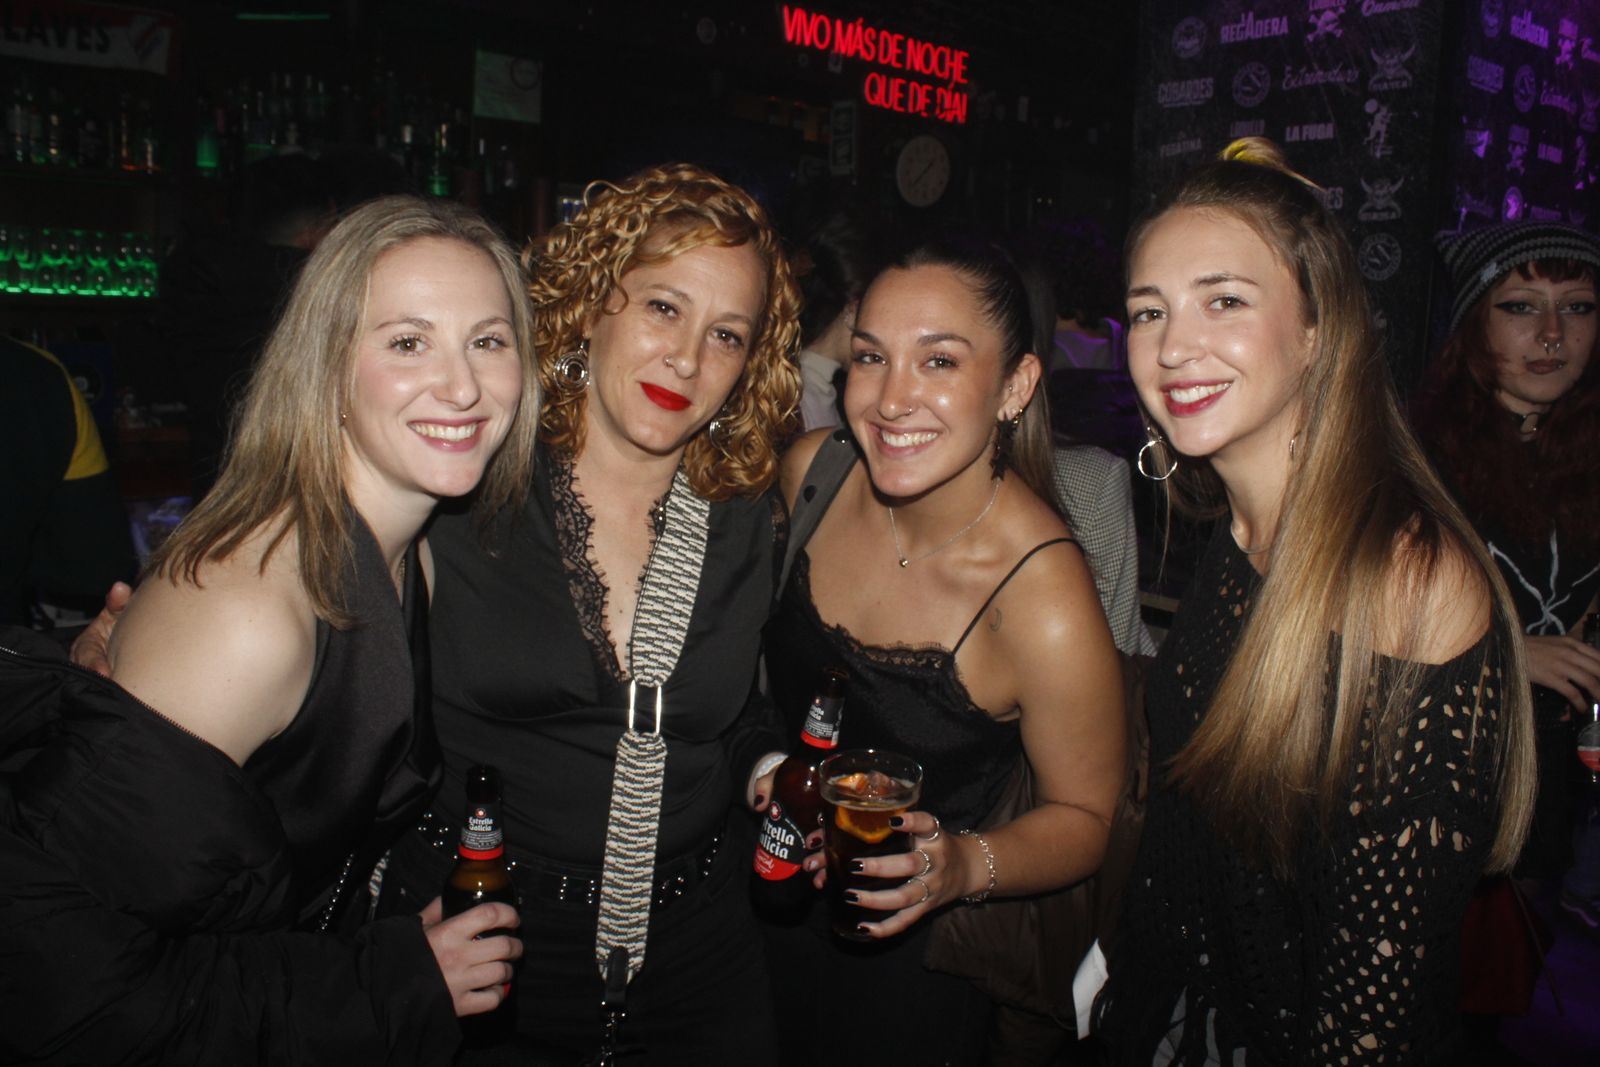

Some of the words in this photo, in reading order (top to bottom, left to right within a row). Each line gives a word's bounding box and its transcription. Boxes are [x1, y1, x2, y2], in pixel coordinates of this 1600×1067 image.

[784, 5, 832, 50] VIVO
[835, 17, 876, 61] MÁS
[878, 30, 904, 68] DE
[906, 37, 969, 84] NOCHE
[864, 72, 906, 112] QUE
[908, 81, 933, 117] DE
[1285, 125, 1301, 142] LA
[1302, 122, 1335, 141] FUGA
